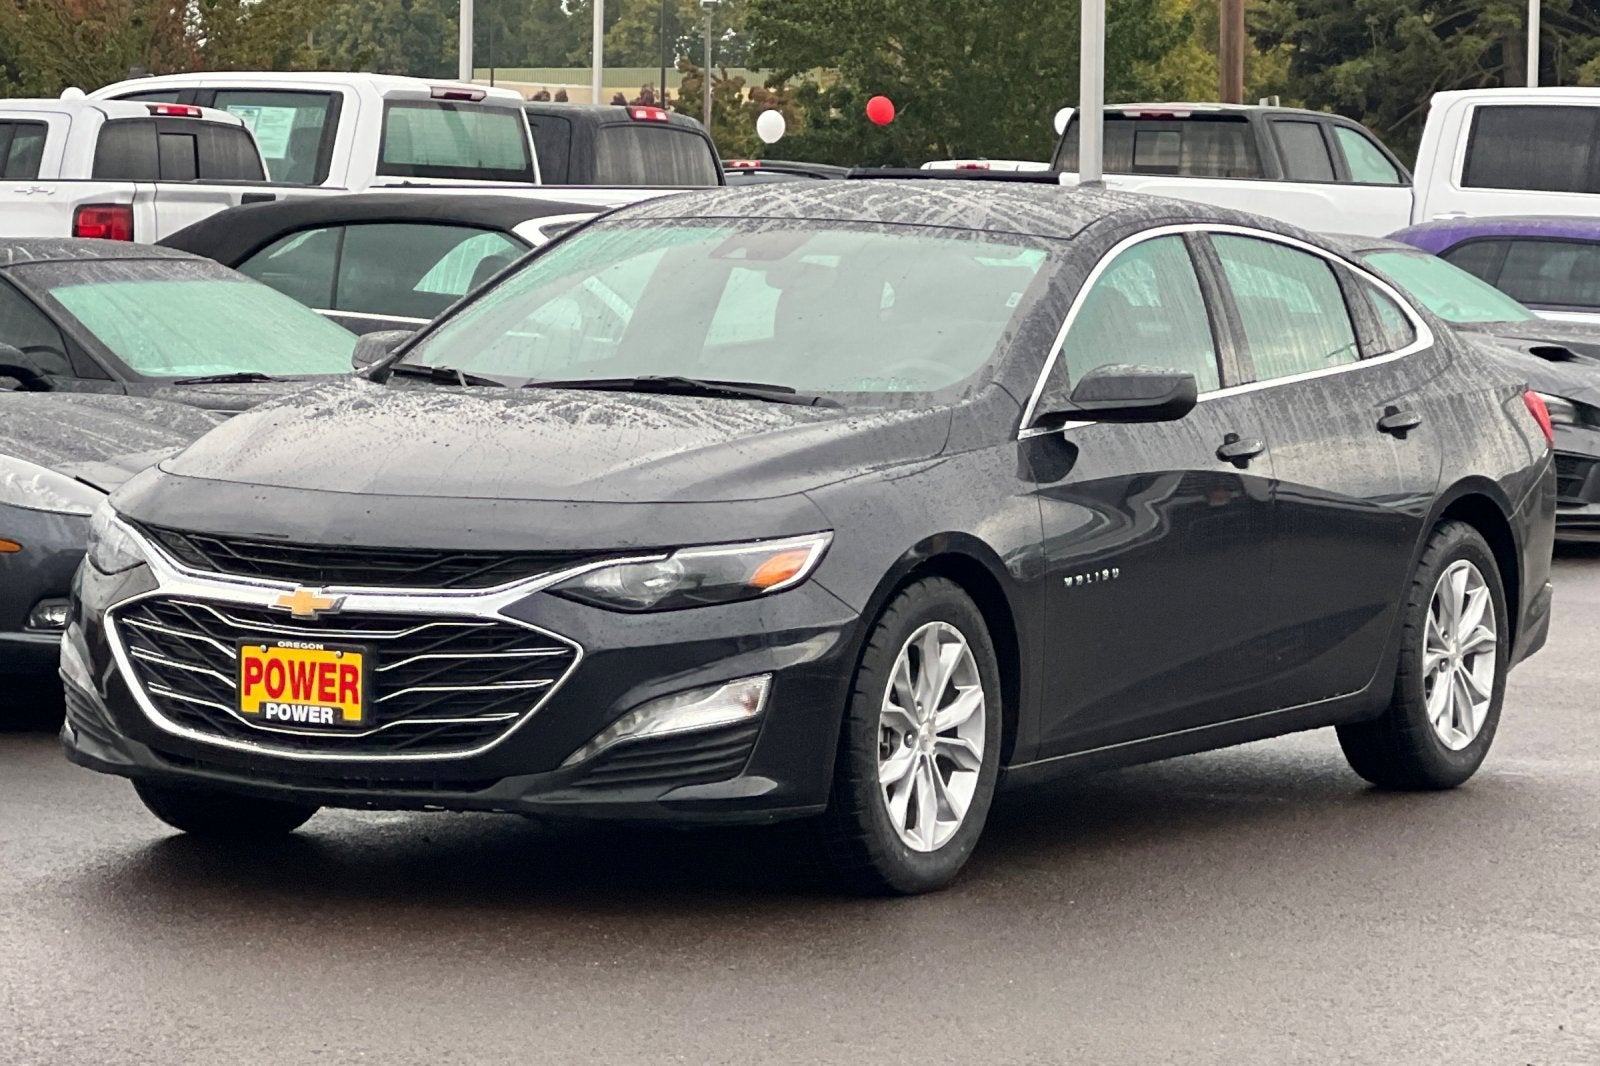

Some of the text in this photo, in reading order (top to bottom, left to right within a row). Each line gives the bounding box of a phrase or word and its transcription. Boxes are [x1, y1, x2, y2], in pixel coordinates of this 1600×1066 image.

[277, 640, 324, 650] OREGON
[244, 657, 359, 704] POWER
[265, 703, 333, 724] POWER
